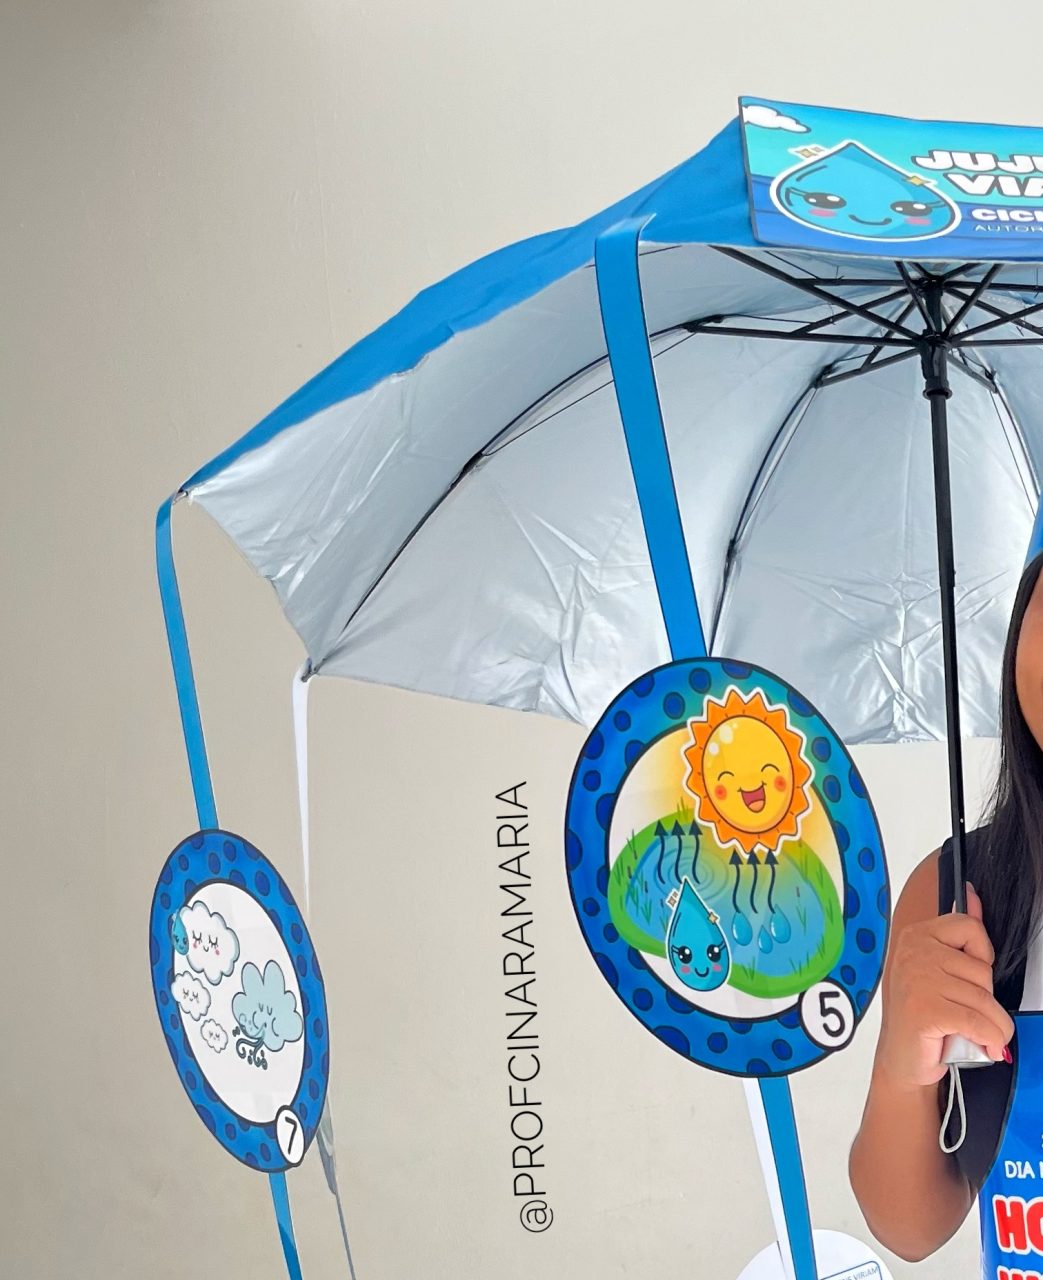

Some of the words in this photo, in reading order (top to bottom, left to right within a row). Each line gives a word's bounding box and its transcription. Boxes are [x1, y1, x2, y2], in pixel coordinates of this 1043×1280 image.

[819, 991, 846, 1037] 5
[285, 1116, 297, 1155] 7
[1004, 1160, 1035, 1179] DIA
